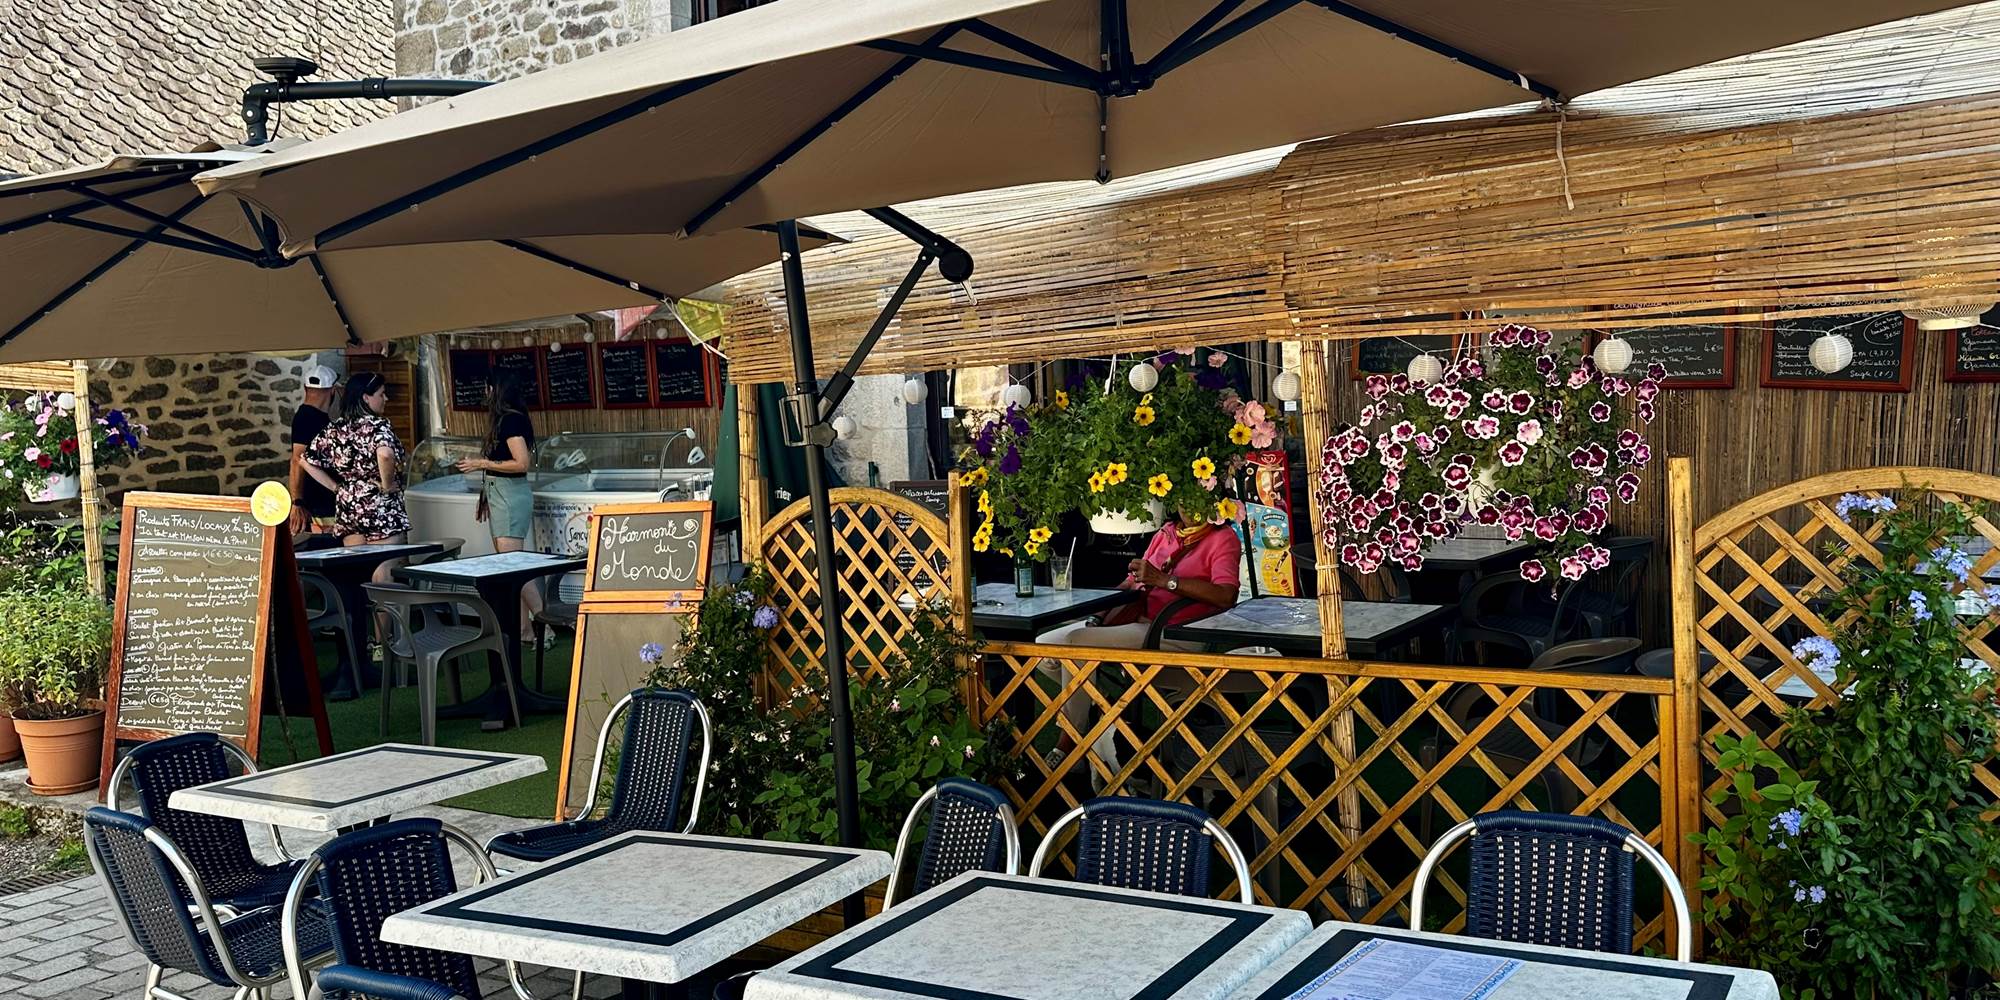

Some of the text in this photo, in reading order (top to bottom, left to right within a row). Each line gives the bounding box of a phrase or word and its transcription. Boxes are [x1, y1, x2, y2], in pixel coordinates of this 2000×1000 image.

[138, 509, 170, 527] Produits
[600, 516, 690, 550] Harmonie
[654, 540, 678, 554] du
[600, 549, 690, 582] Monde
